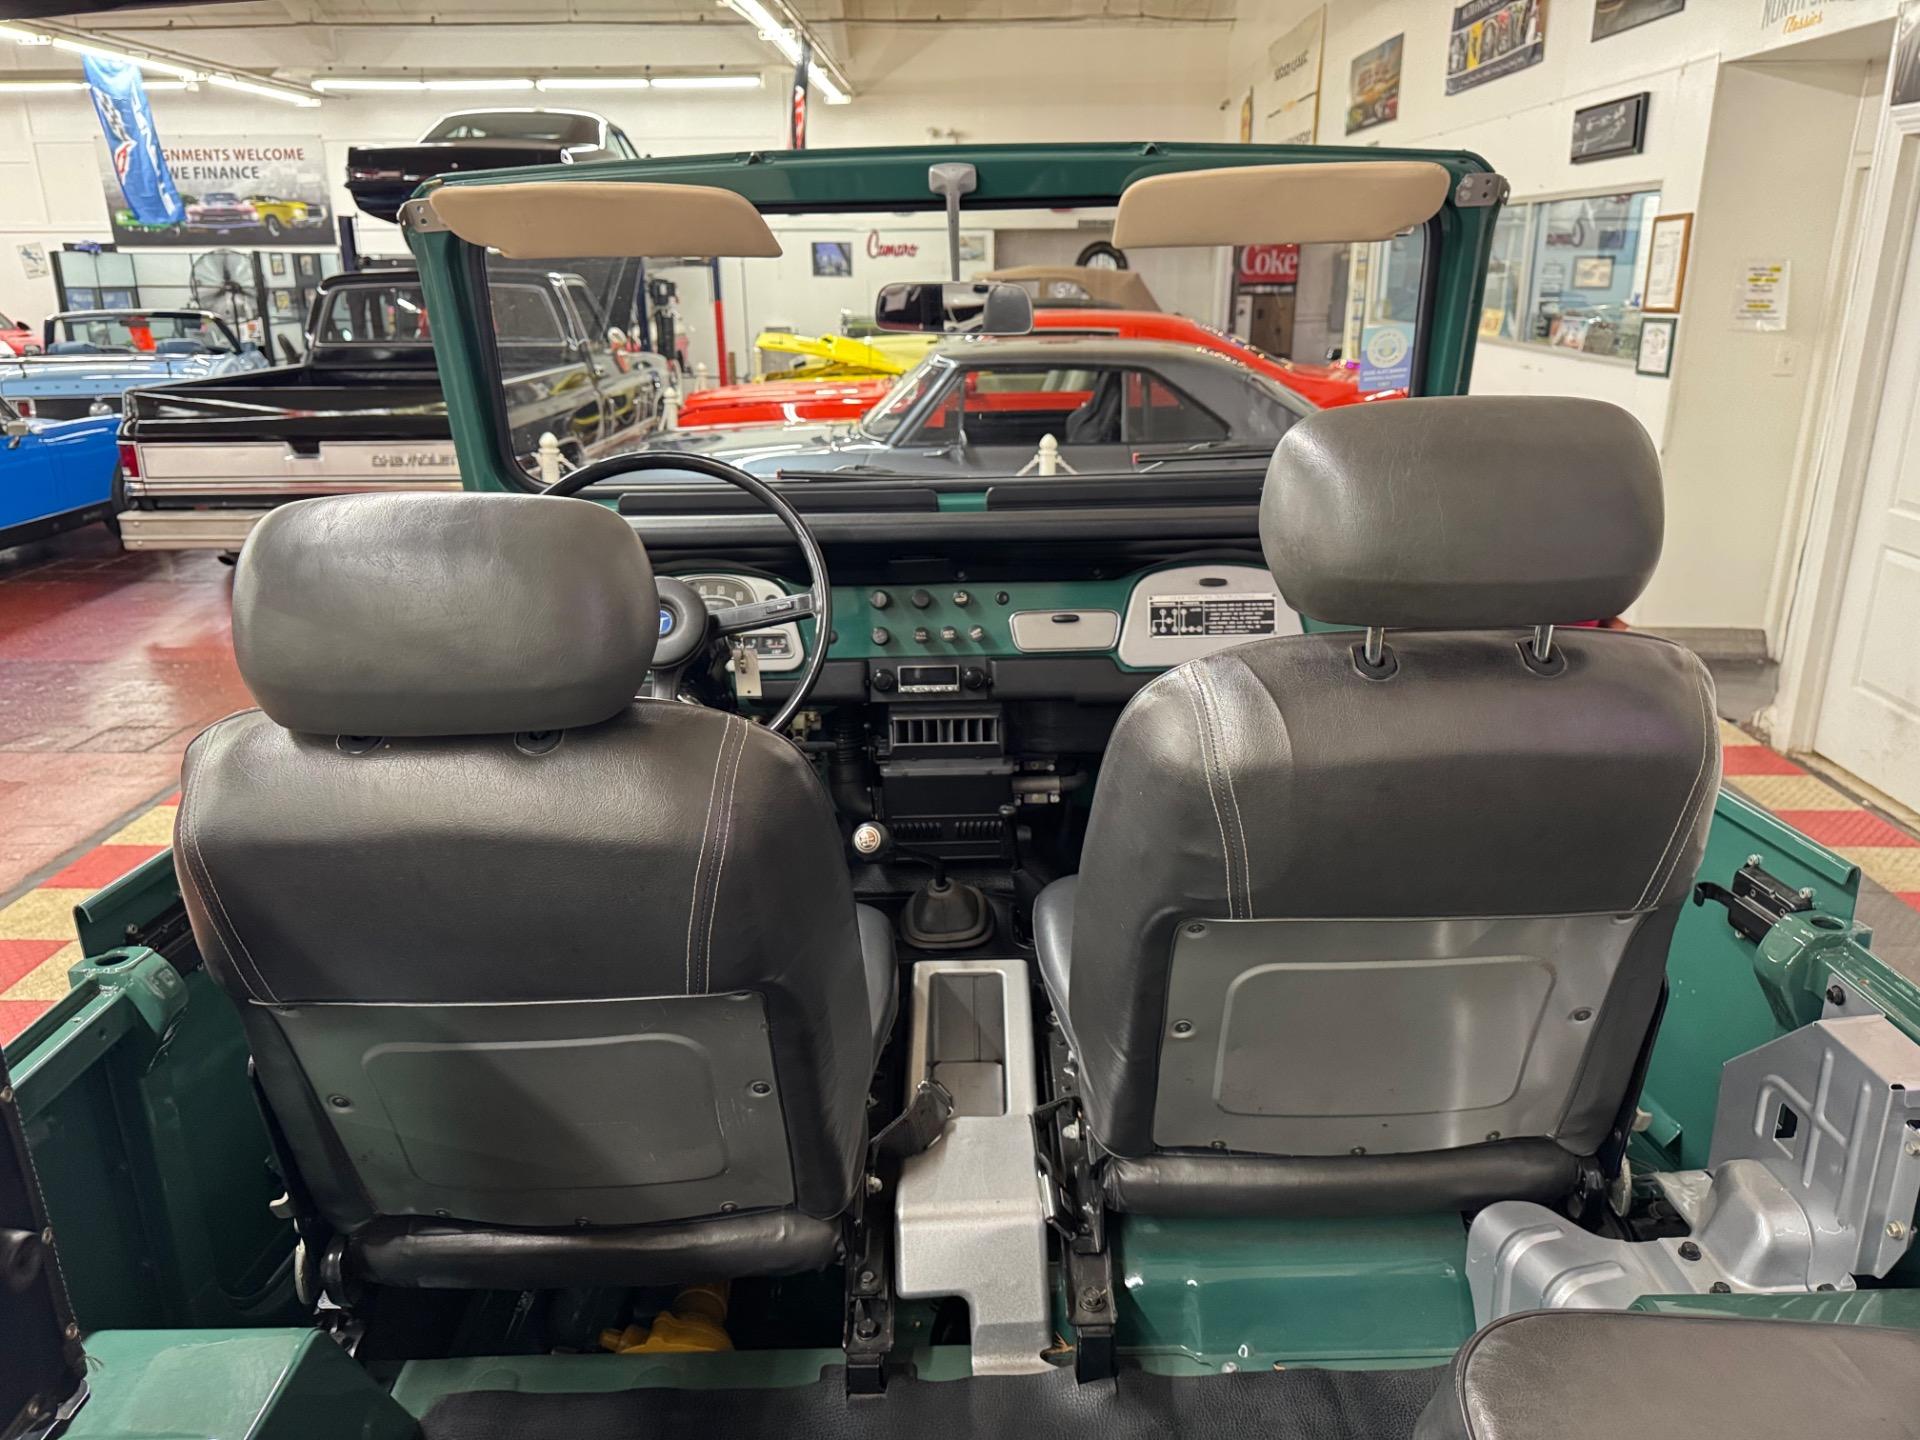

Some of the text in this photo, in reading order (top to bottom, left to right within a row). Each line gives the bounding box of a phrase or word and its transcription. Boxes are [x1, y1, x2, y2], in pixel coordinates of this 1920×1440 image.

[1760, 0, 1806, 31] NOR
[162, 147, 305, 161] GNMENTS WELCOME
[193, 166, 261, 180] FINANCE
[866, 229, 919, 259] Camaro
[1240, 244, 1298, 275] Coke
